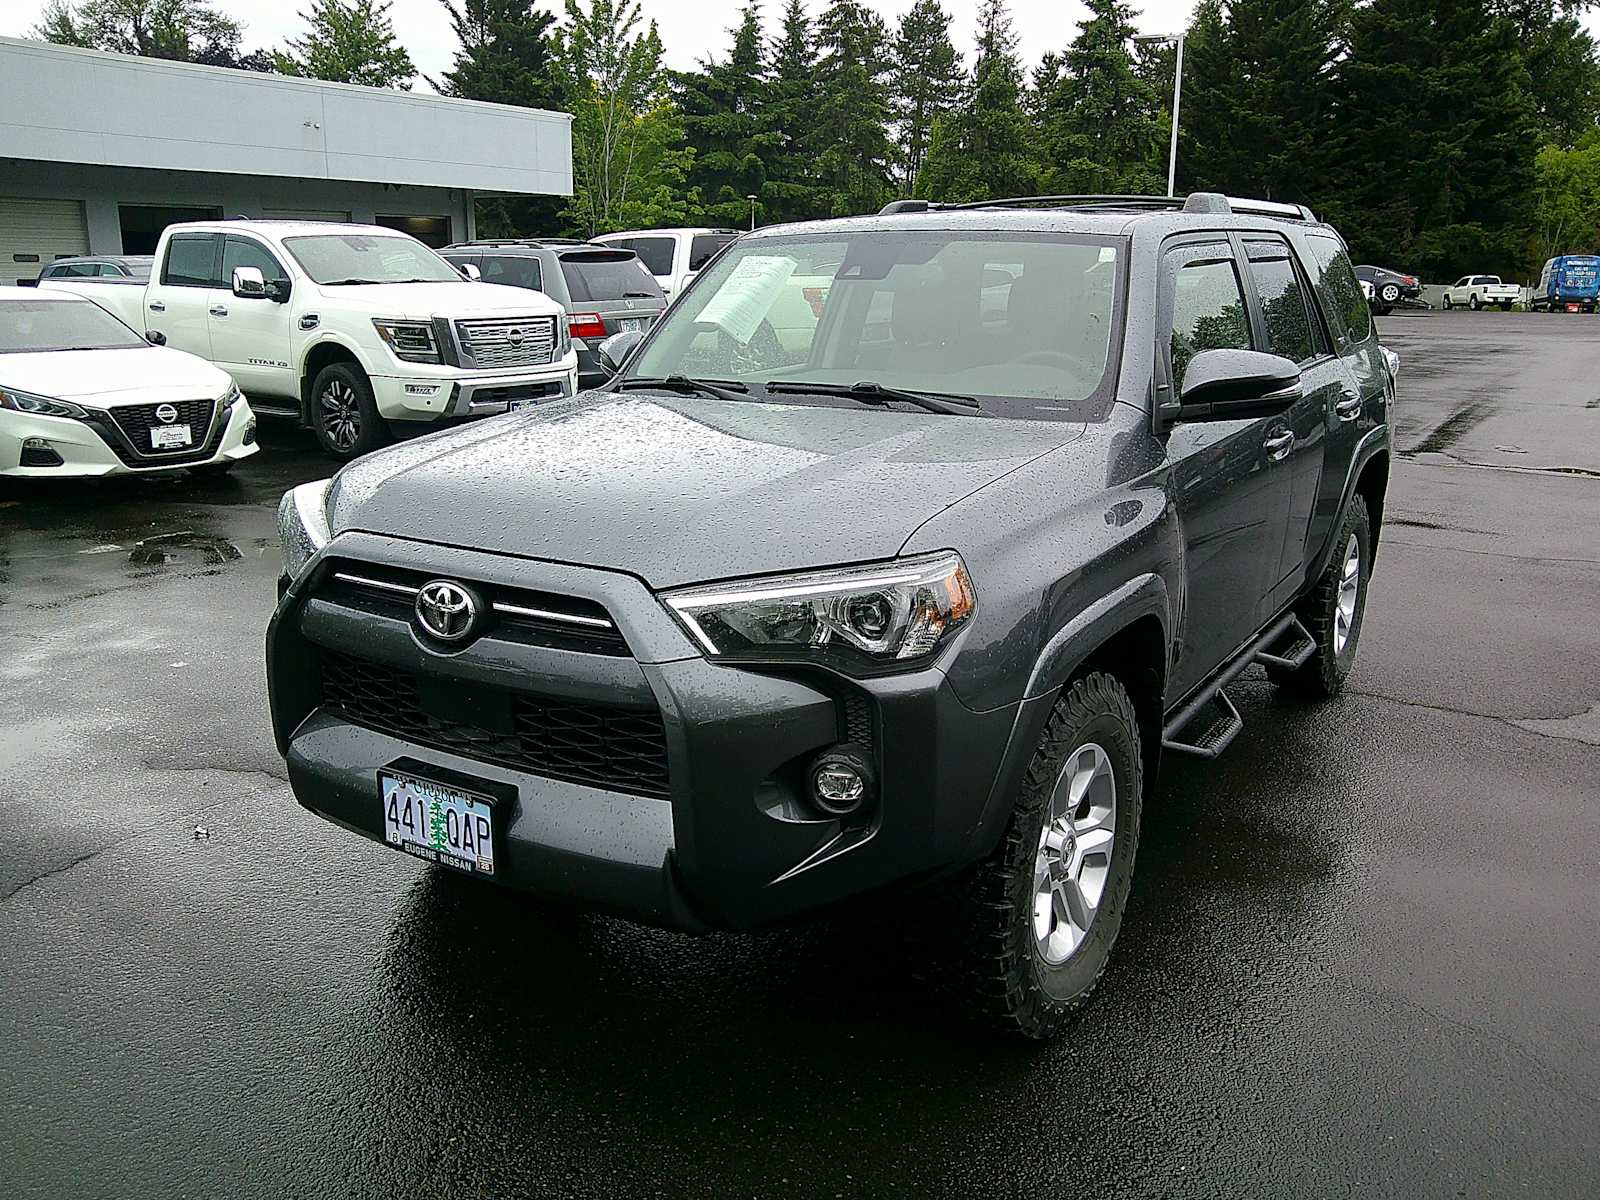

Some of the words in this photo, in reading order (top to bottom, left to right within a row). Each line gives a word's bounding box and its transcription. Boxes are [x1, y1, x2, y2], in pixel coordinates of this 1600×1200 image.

[248, 357, 275, 366] TITAN
[388, 791, 426, 839] 441
[446, 808, 490, 855] QAP
[404, 843, 437, 860] EUGENE
[440, 853, 472, 872] NISSAN
